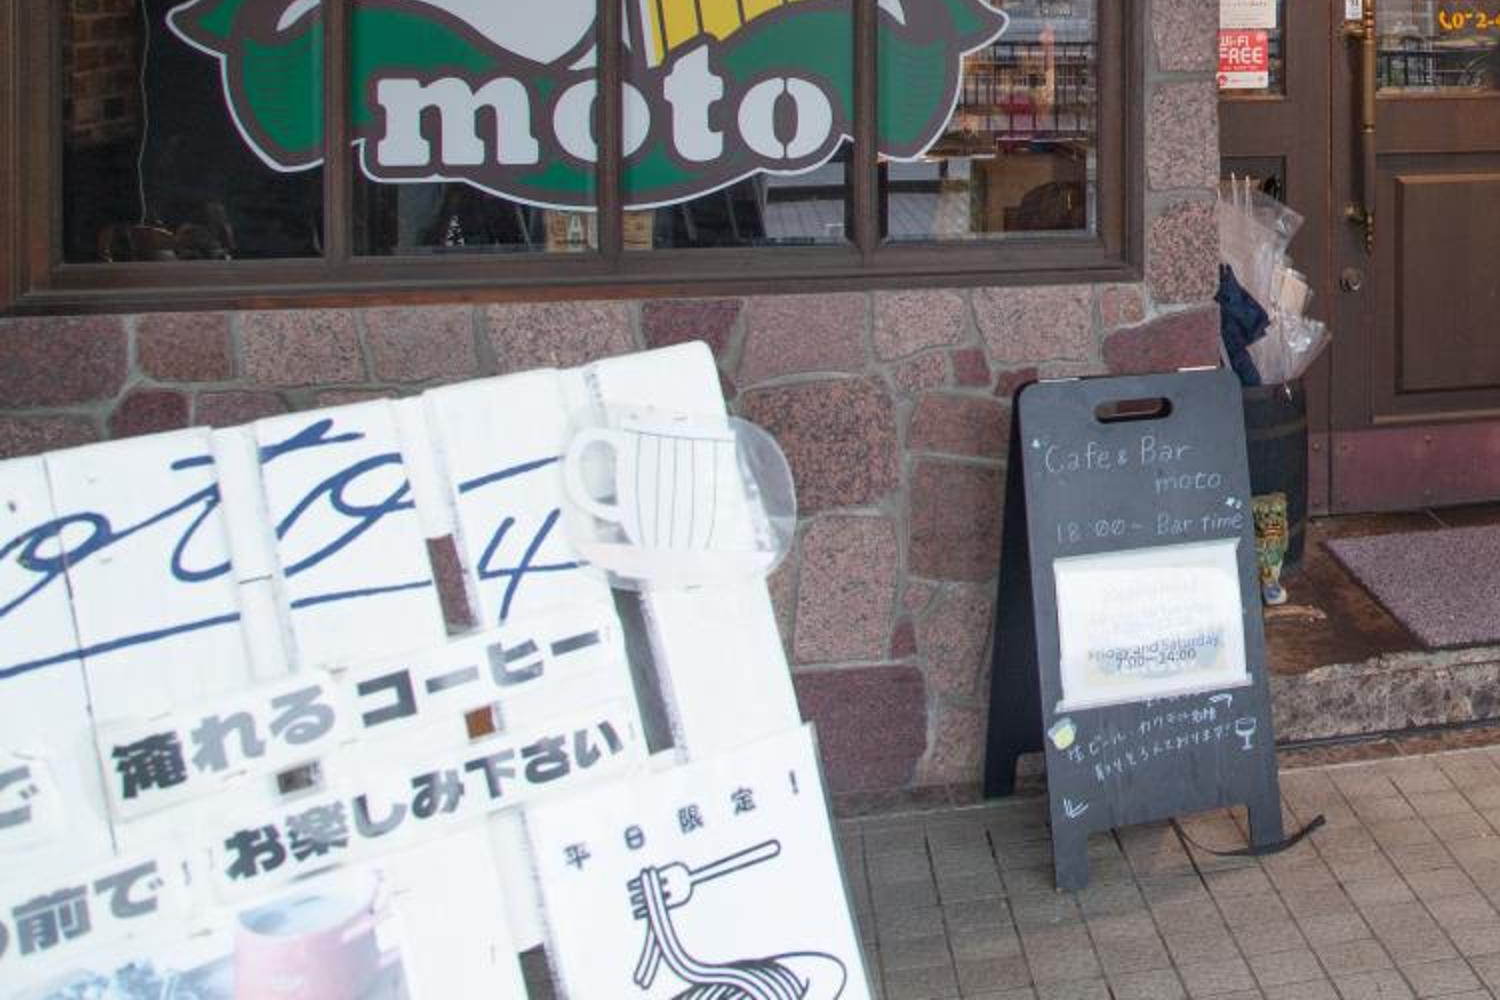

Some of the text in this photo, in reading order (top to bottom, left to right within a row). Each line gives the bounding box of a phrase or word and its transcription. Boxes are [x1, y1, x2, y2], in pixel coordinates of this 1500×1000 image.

[376, 42, 834, 168] moto
[1140, 435, 1194, 465] Bar
[0, 860, 164, 958] 前で
